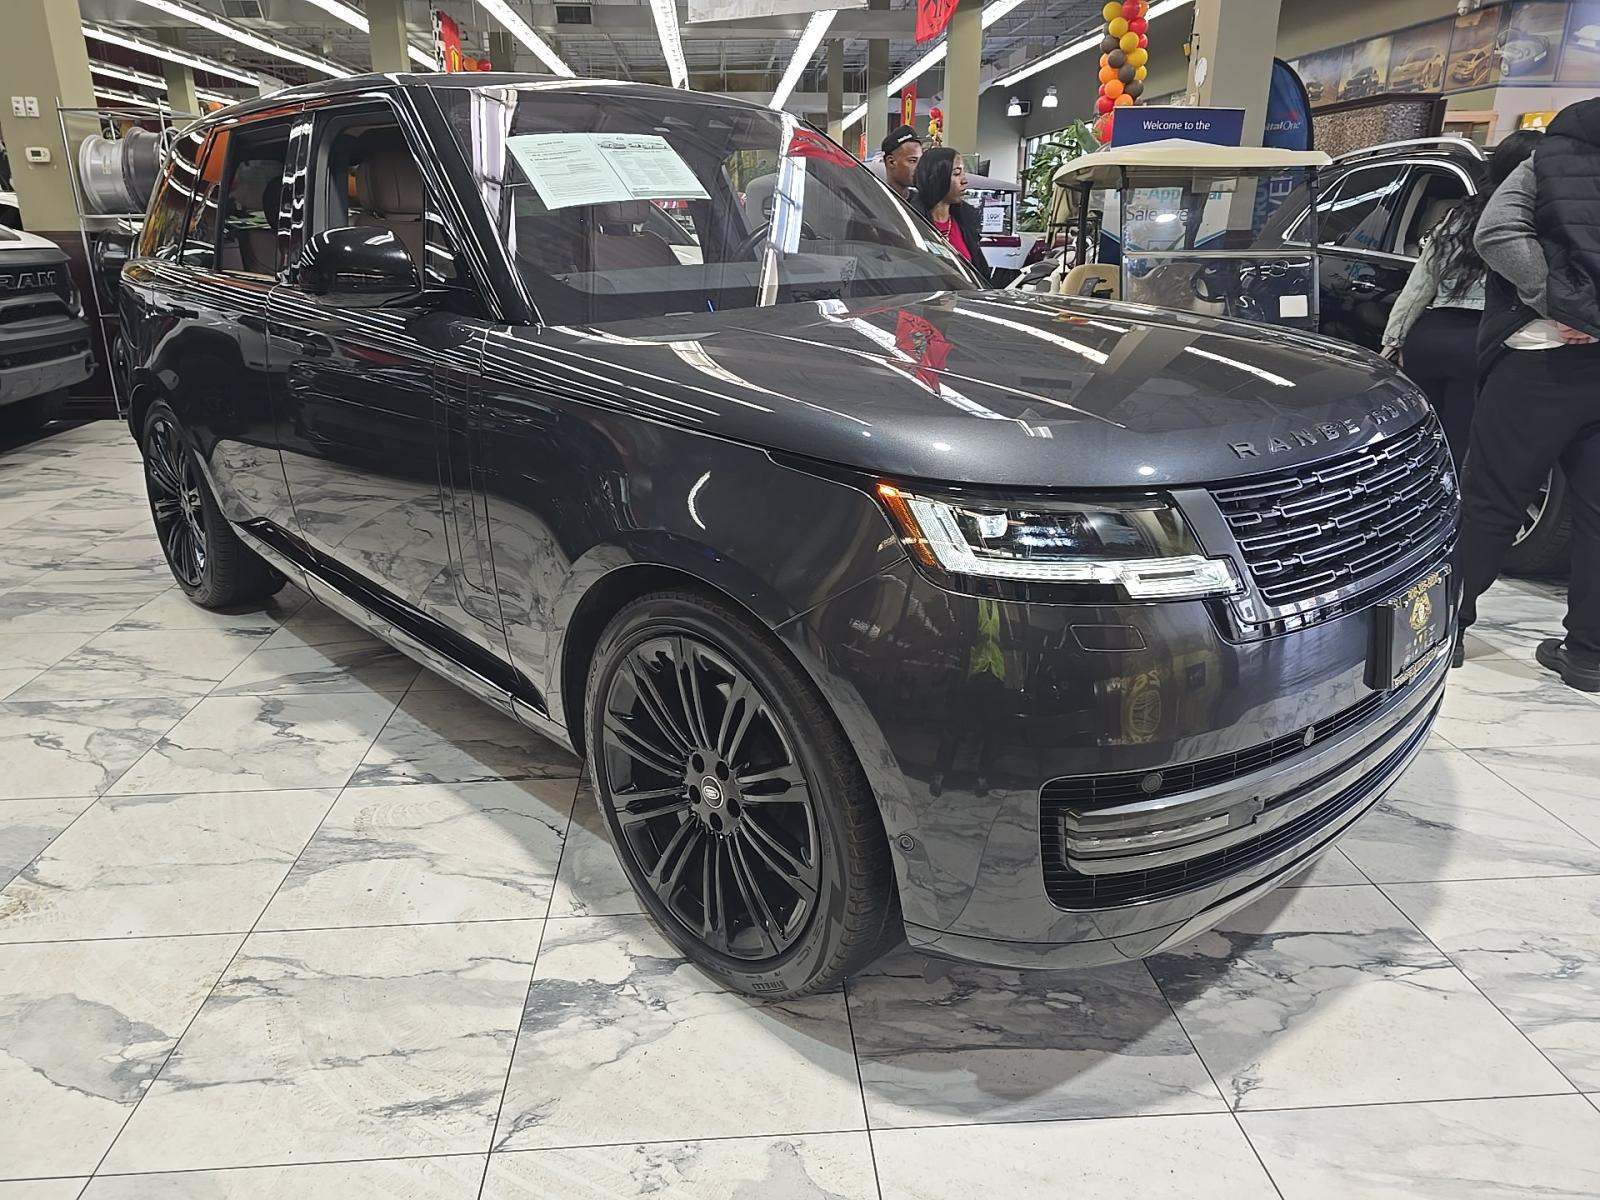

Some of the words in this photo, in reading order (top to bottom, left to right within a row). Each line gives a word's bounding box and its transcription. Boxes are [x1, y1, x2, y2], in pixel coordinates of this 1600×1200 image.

[1142, 120, 1183, 131] Welcome
[1184, 121, 1195, 131] to
[1195, 120, 1211, 131] the
[0, 270, 57, 290] RAM
[1226, 418, 1361, 460] RANGE
